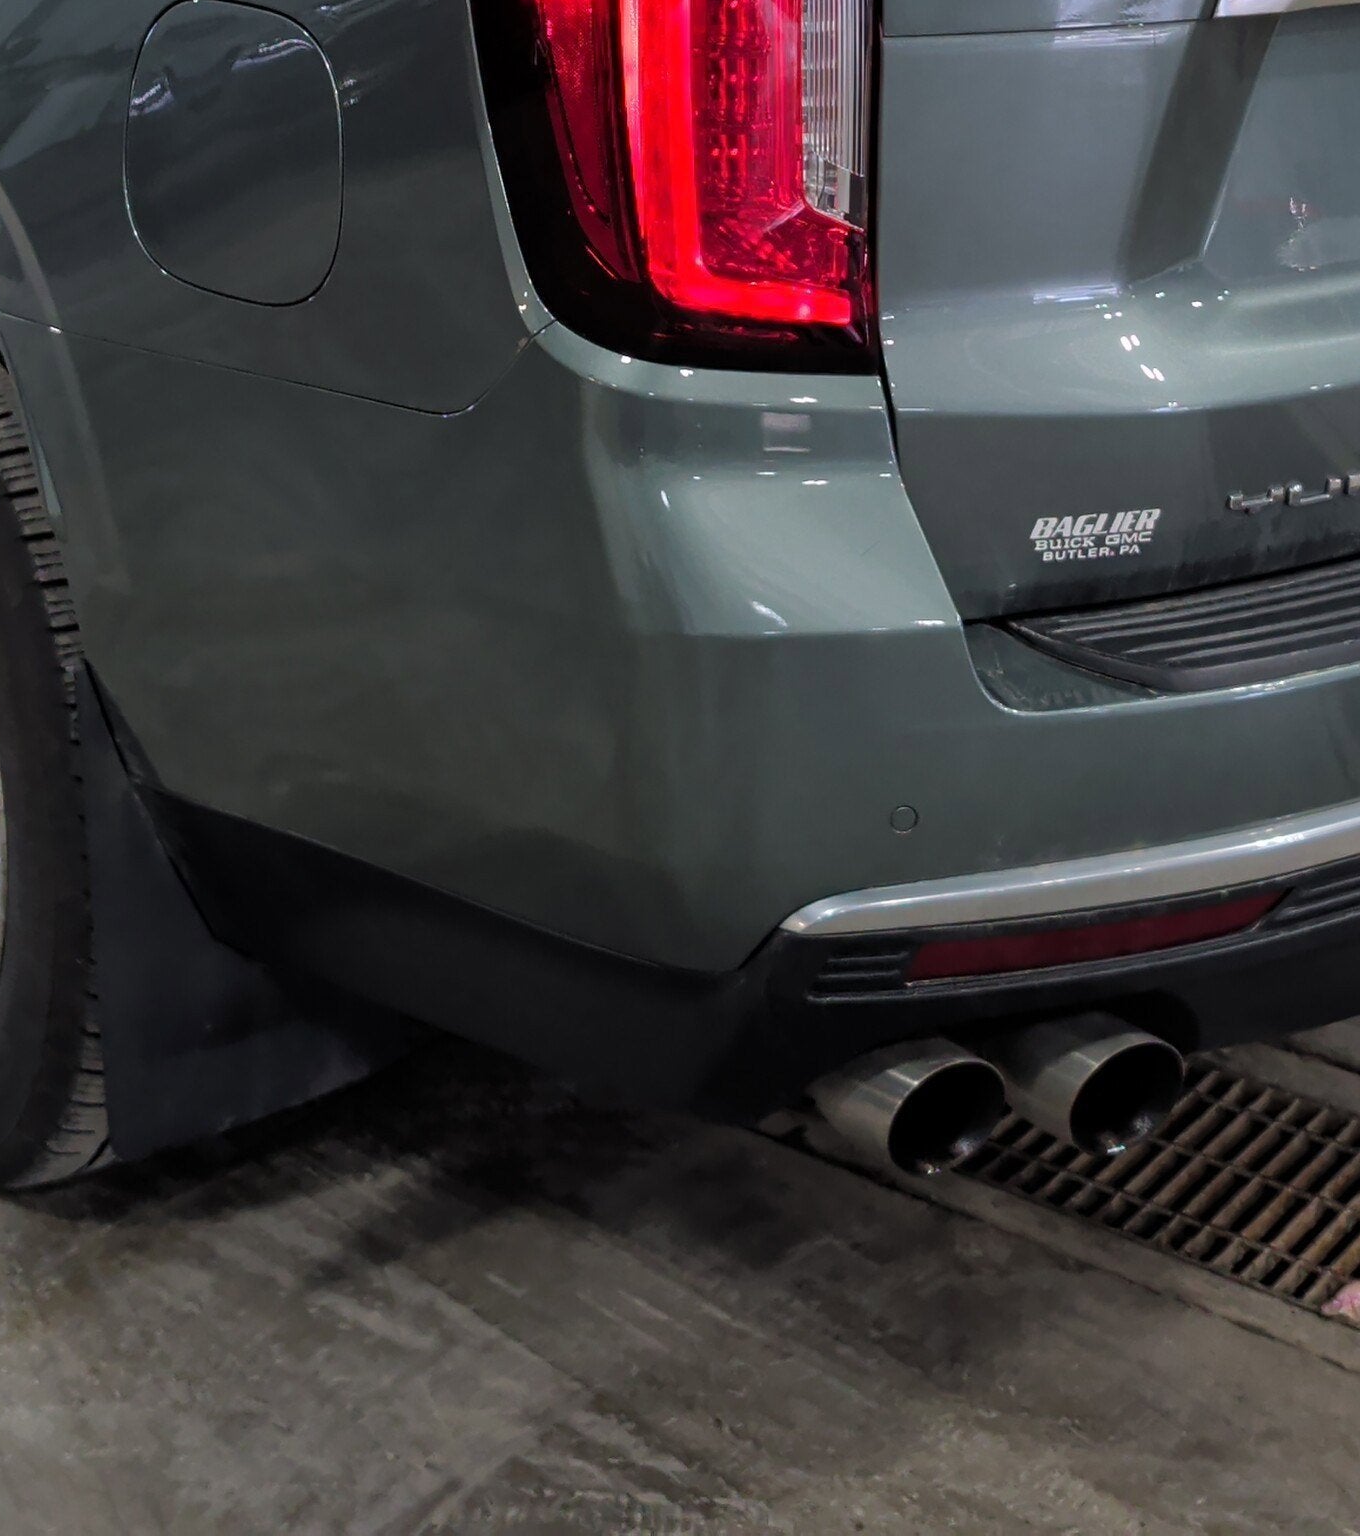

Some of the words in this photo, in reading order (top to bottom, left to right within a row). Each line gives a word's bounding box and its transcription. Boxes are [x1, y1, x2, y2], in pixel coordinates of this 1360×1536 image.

[1030, 508, 1161, 539] BAGLIER
[1035, 536, 1095, 551] BUICK
[1105, 531, 1152, 545] GMC
[1119, 544, 1140, 555] PA
